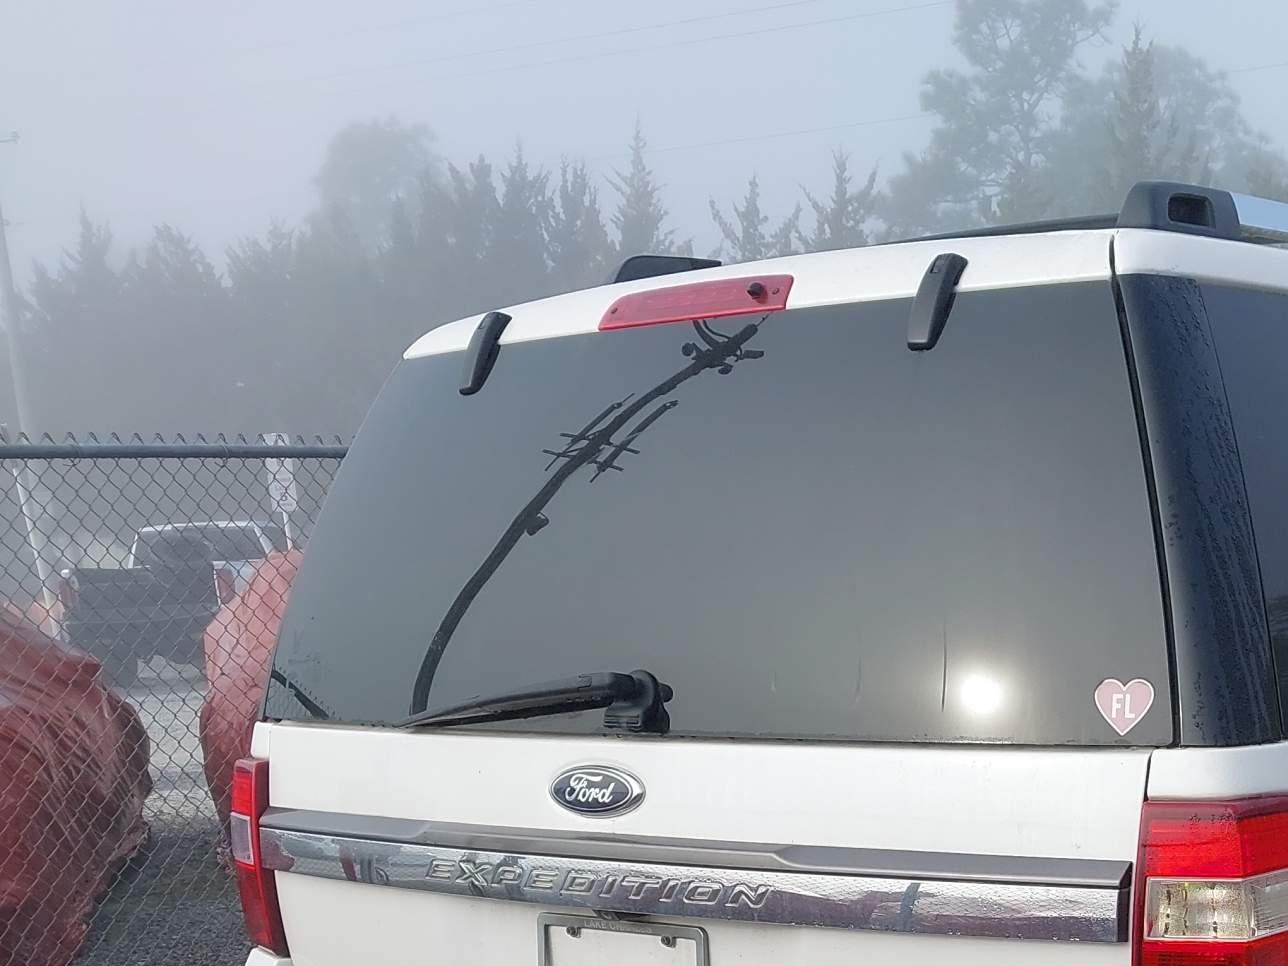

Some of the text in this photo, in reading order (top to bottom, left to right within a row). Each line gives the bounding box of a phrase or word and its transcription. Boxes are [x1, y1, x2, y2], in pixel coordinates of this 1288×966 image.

[1111, 693, 1136, 719] FL
[565, 774, 617, 804] Ford
[425, 857, 777, 909] EXPEDITION
